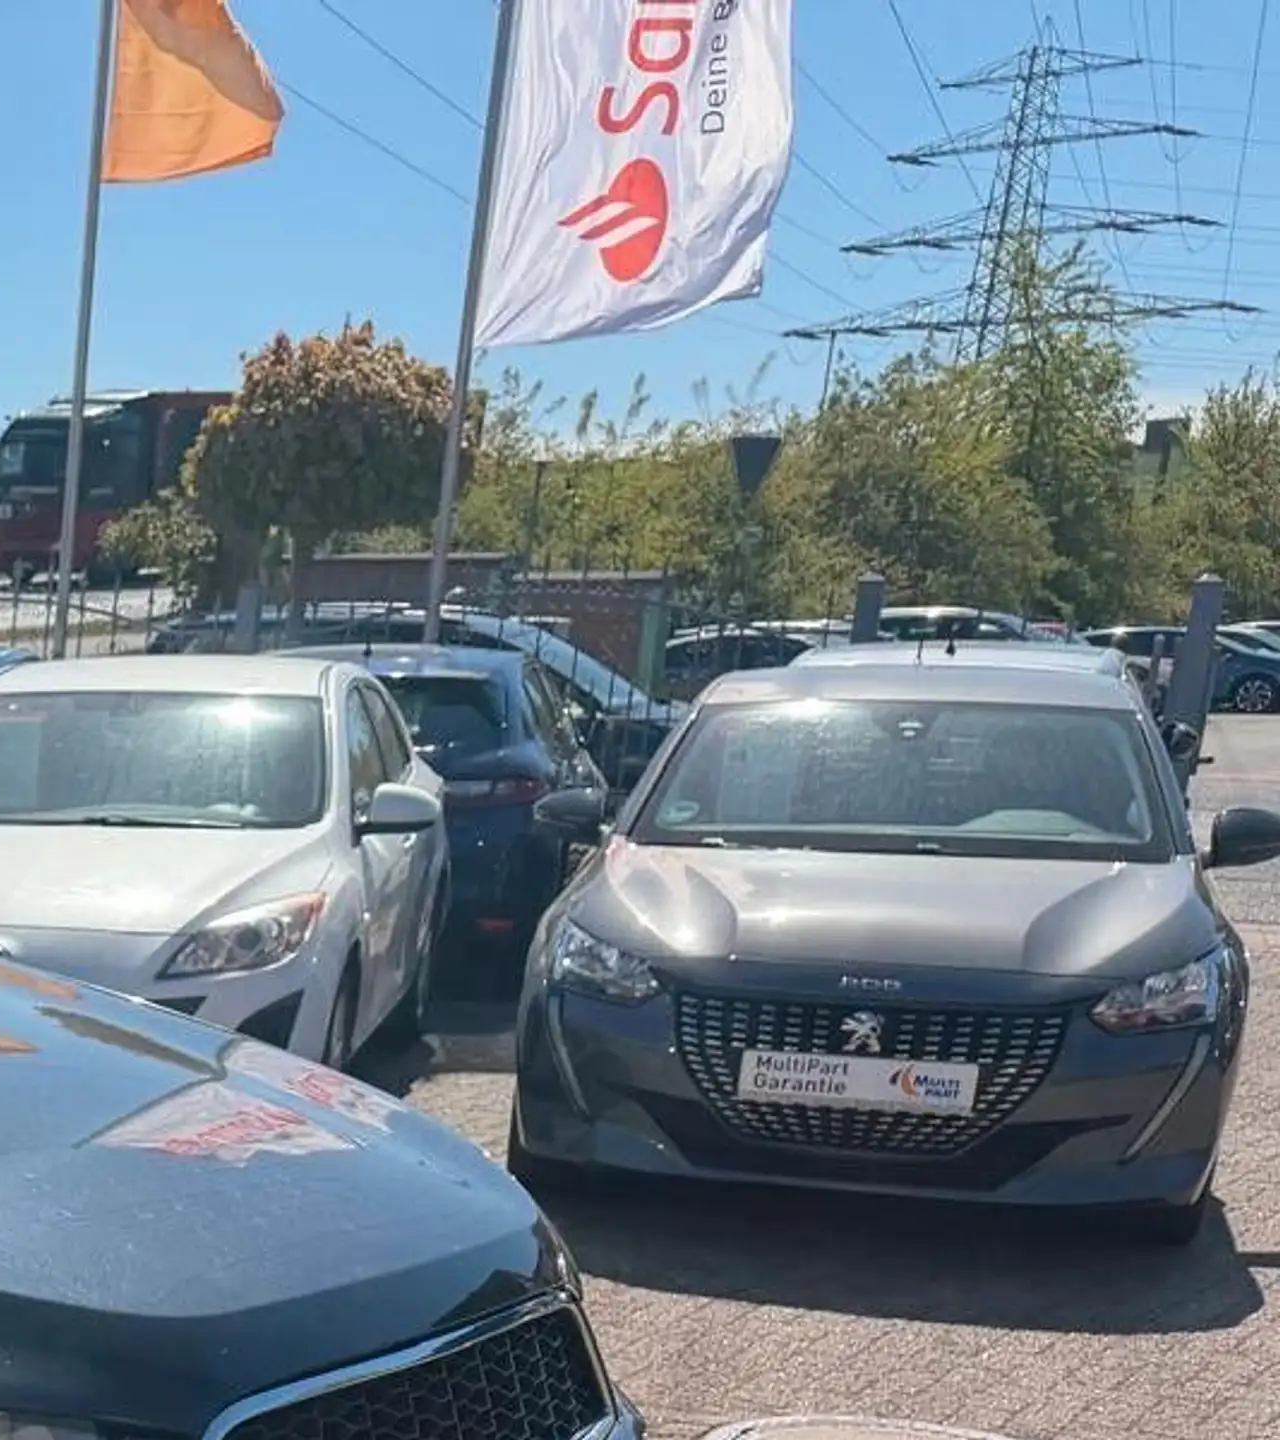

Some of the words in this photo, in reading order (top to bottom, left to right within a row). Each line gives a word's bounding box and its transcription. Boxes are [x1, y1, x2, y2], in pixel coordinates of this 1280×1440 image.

[700, 33, 727, 135] Deine
[755, 1055, 849, 1076] MultiPart
[753, 1074, 847, 1095] Garantie
